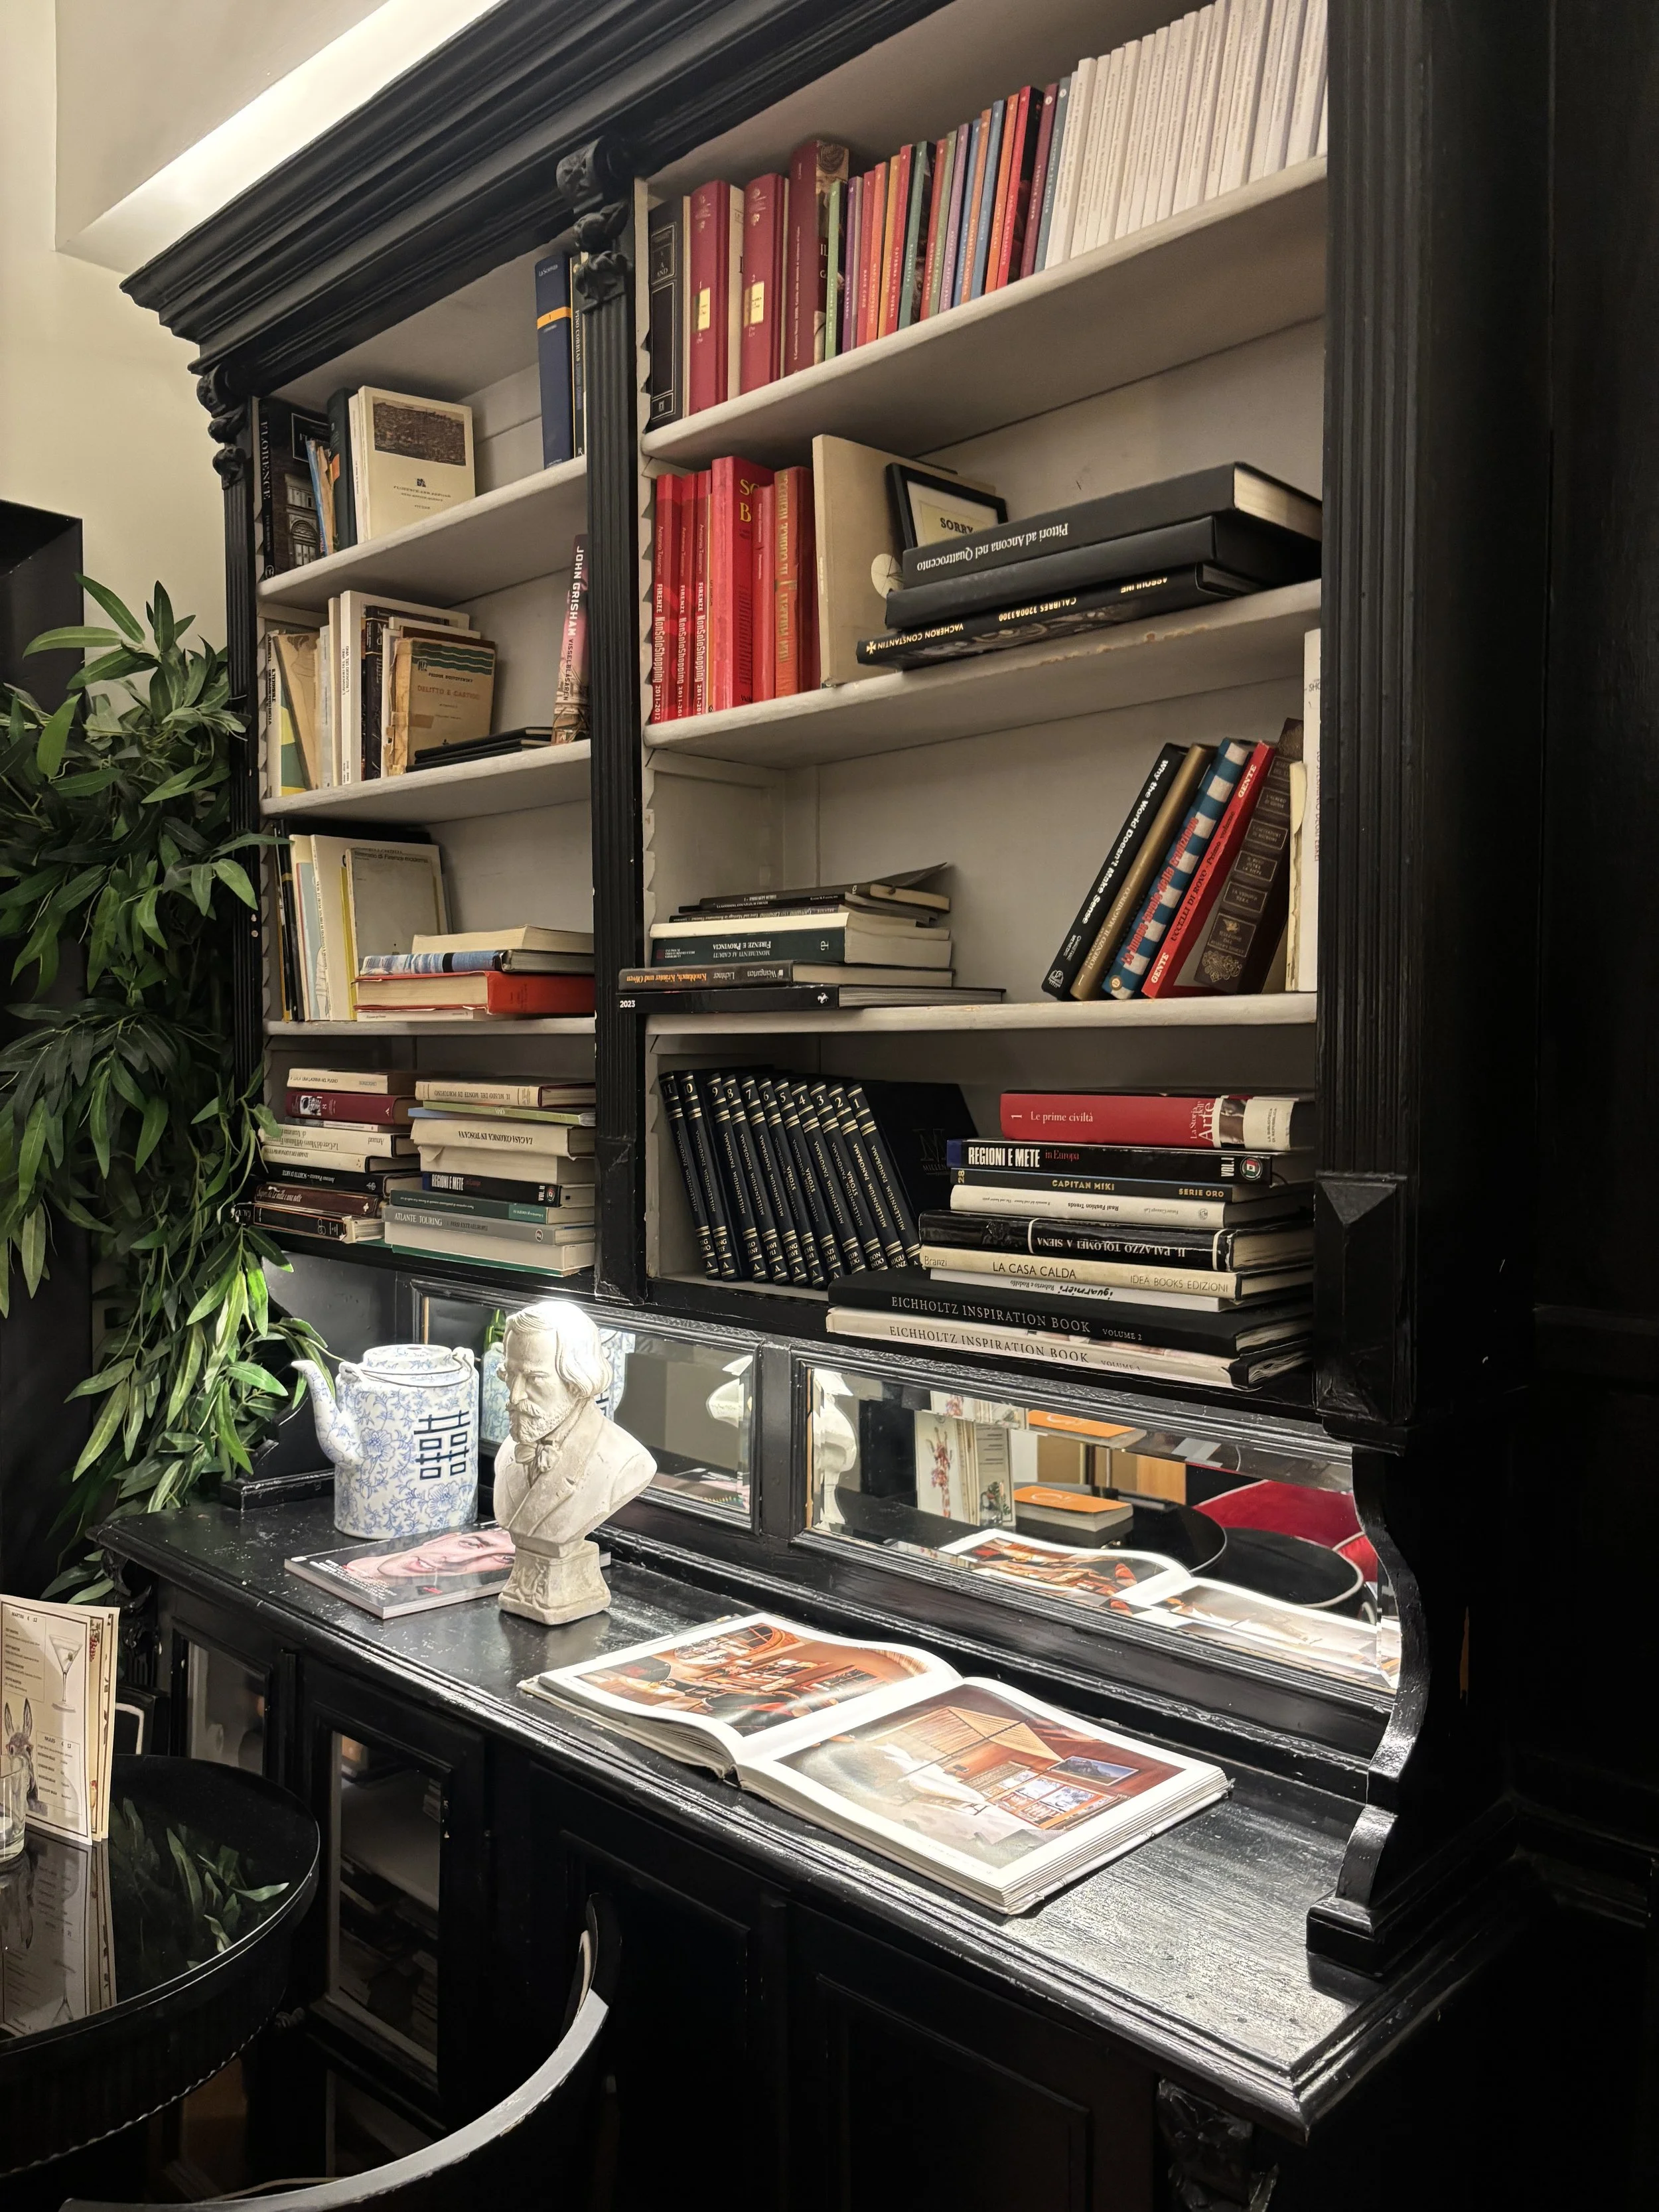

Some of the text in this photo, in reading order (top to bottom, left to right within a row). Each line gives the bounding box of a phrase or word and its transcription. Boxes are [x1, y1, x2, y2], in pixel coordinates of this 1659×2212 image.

[259, 421, 271, 500] FLORENCE
[940, 518, 974, 534] SORRY
[916, 523, 1068, 571] Pittori ad Ancona nel Quattrocento
[573, 546, 584, 579] JOHN
[567, 583, 581, 636] GRISHAM
[999, 597, 1076, 622] CALIBRES 3200&3300
[694, 615, 706, 683] NonSoloShopping
[878, 623, 964, 650] VACHERON CONSTANTIN
[652, 616, 665, 684] NonSoloShopping
[677, 617, 687, 684] NonSoloShopping
[1154, 759, 1169, 781] Why
[1238, 764, 1257, 798] GENTE
[1145, 781, 1158, 798] the
[1129, 800, 1149, 828] World
[1112, 828, 1133, 866] Doesn't
[1157, 816, 1200, 893] della tradizione
[1097, 867, 1116, 894] Make
[1170, 810, 1236, 942] UCCELLI DI ROVO Primo volume
[1082, 894, 1101, 924] Sense
[1088, 936, 1106, 970] LORENZO
[1104, 927, 1112, 938] IL
[1109, 887, 1131, 927] MAGNIFICO
[626, 975, 644, 984] Oliven
[655, 974, 676, 983] Kräuter
[747, 969, 777, 978] Weingarten
[1151, 952, 1169, 984] GENTE
[711, 1086, 719, 1097] 9
[727, 1088, 734, 1099] 8
[745, 1088, 752, 1100] 7
[762, 1089, 769, 1102] 6
[779, 1092, 786, 1103] 5
[798, 1094, 806, 1106] 4
[816, 1095, 824, 1106] 3
[834, 1096, 844, 1108] 2
[853, 1098, 861, 1109] 1
[1030, 1111, 1094, 1124] Le prime civiltà
[1198, 1102, 1215, 1142] Arte
[458, 1131, 481, 1140] TOSCANA
[488, 1133, 512, 1142] COLONICA
[512, 1136, 526, 1144] CASA
[1190, 1130, 1198, 1139] La
[968, 1147, 1080, 1167] REGIONI E METE in Europa
[431, 1174, 464, 1191] REGIONI E METE
[723, 1132, 746, 1215] MILLENNIUM PANORAMA
[739, 1133, 765, 1216] MILLENNIUM PANORAMA
[758, 1134, 784, 1217] MILLENNIUM PANORAMA
[786, 1165, 796, 1191] STORIA
[805, 1167, 816, 1193] STORIA
[814, 1141, 844, 1224] MILLENNIUM PANORAMA
[847, 1171, 859, 1197] STORIA
[853, 1142, 887, 1228] MILLENNIUM PANORAMA
[958, 1170, 965, 1184] 28
[1052, 1179, 1115, 1191] CAPITAN MIKI
[871, 1145, 906, 1231] MILLENNIUM PANORAMA
[1179, 1188, 1224, 1198] SERIE ORO
[394, 1213, 443, 1226] ATLANTE TOURING
[1037, 1237, 1171, 1256] PALAZZO TOLOMEI A SIENA
[924, 1255, 1228, 1293] Branzi LA CASA CALDA IDEA BOOKS EDIZIONI
[1037, 1283, 1055, 1291] Roberto
[891, 1296, 959, 1315] EICHHOLTZ
[962, 1305, 1046, 1326] INSPIRATION
[1051, 1317, 1091, 1333] BOOK
[1102, 1328, 1136, 1340] VOLUME
[889, 1326, 1135, 1370] EICHHOLTZ INSPIRATION BOOK VOLUME
